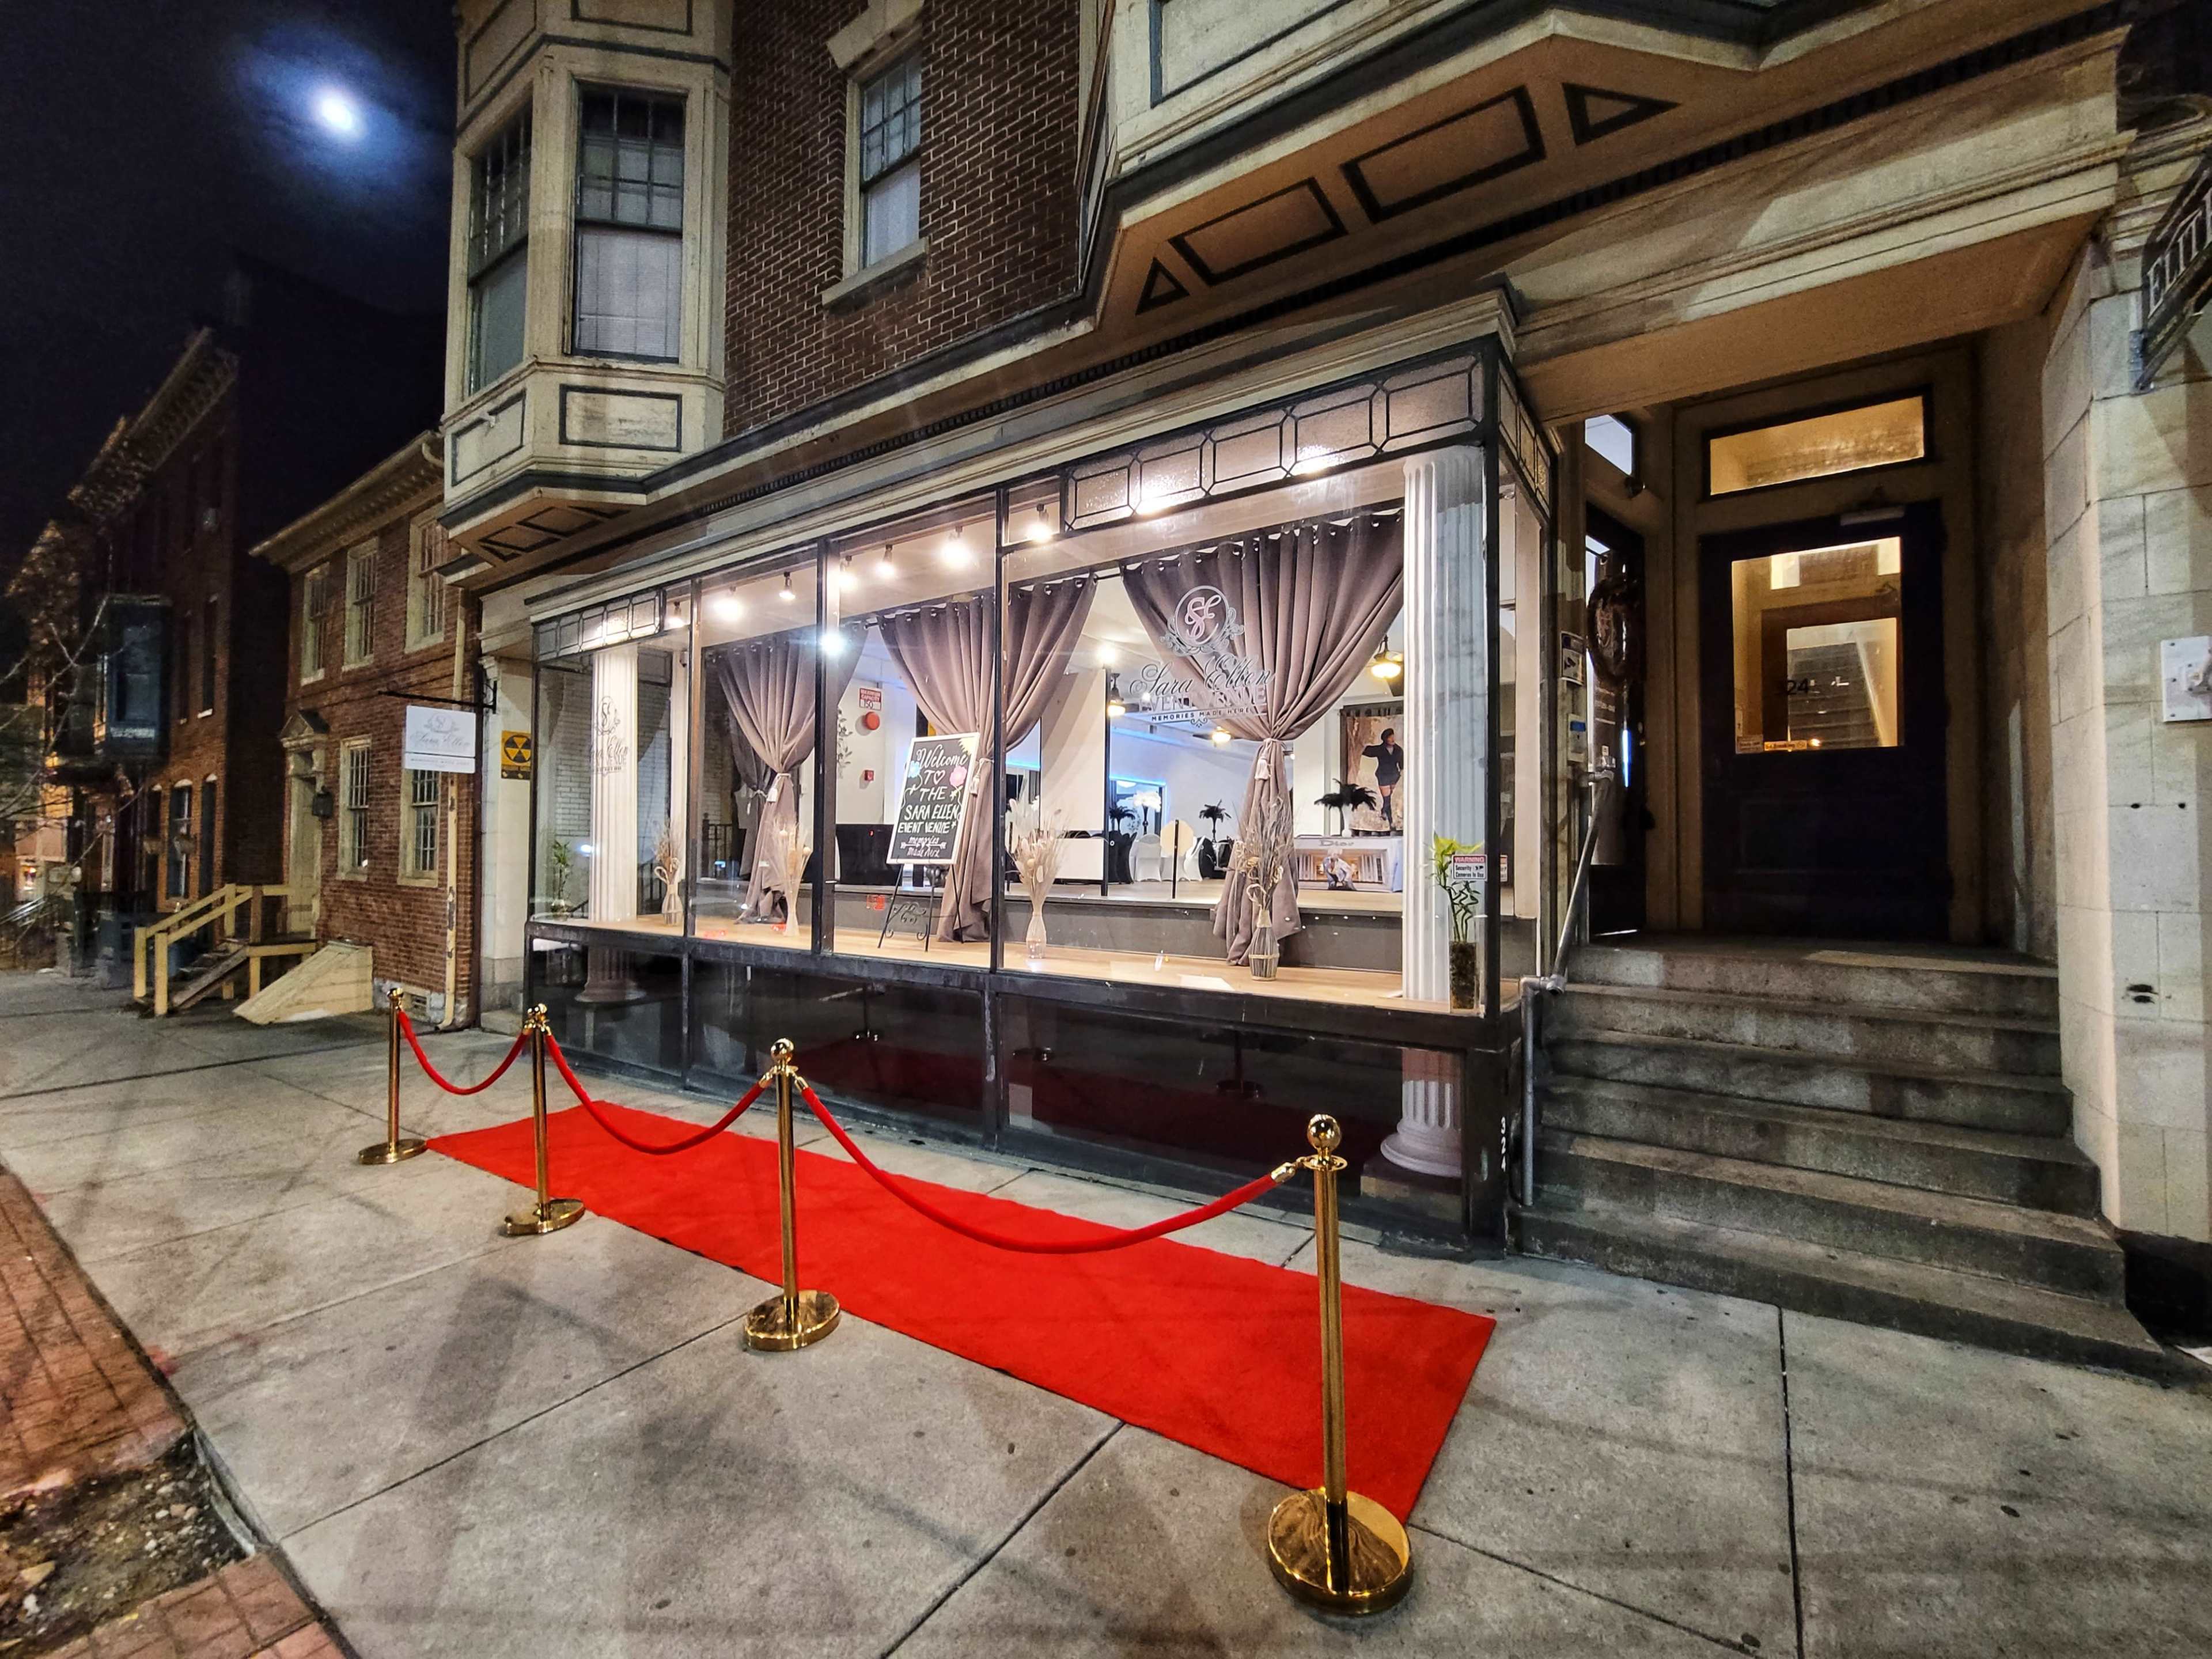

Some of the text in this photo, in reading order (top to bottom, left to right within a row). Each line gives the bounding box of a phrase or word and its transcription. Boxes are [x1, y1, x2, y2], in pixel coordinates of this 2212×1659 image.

[1130, 653, 1274, 696] Sara Ellen
[861, 694, 880, 702] CAPACITY
[1152, 713, 1195, 721] MEMORIES
[1228, 706, 1250, 714] HERE
[916, 744, 968, 770] Welcome
[919, 786, 948, 802] THE
[904, 804, 960, 820] SARA ELLEN
[897, 821, 950, 834] EVENT VENUE
